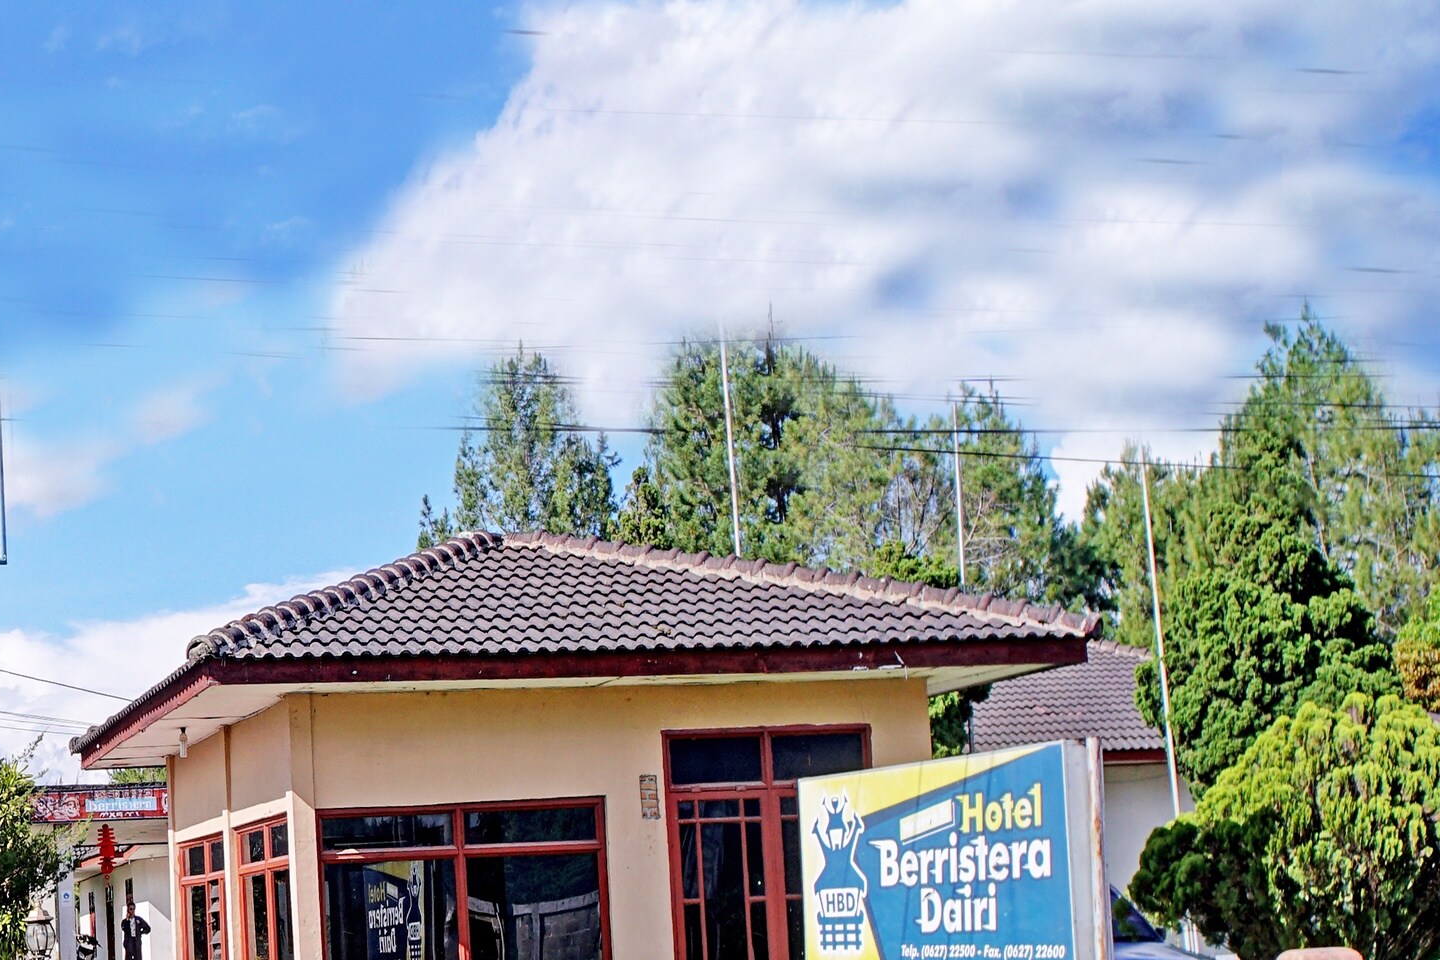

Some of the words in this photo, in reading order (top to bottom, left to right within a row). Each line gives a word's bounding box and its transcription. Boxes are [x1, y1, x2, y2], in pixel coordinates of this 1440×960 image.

[956, 783, 1042, 834] Hotel
[868, 832, 1052, 887] Berristera
[825, 892, 857, 913] HBD
[915, 882, 998, 933] Dairi
[901, 944, 920, 960] Telp.
[921, 944, 948, 960] (0627)
[949, 944, 976, 959] 22500
[983, 944, 1002, 959] Fax.
[1003, 944, 1033, 960] (0627)
[1035, 945, 1066, 960] 22600
